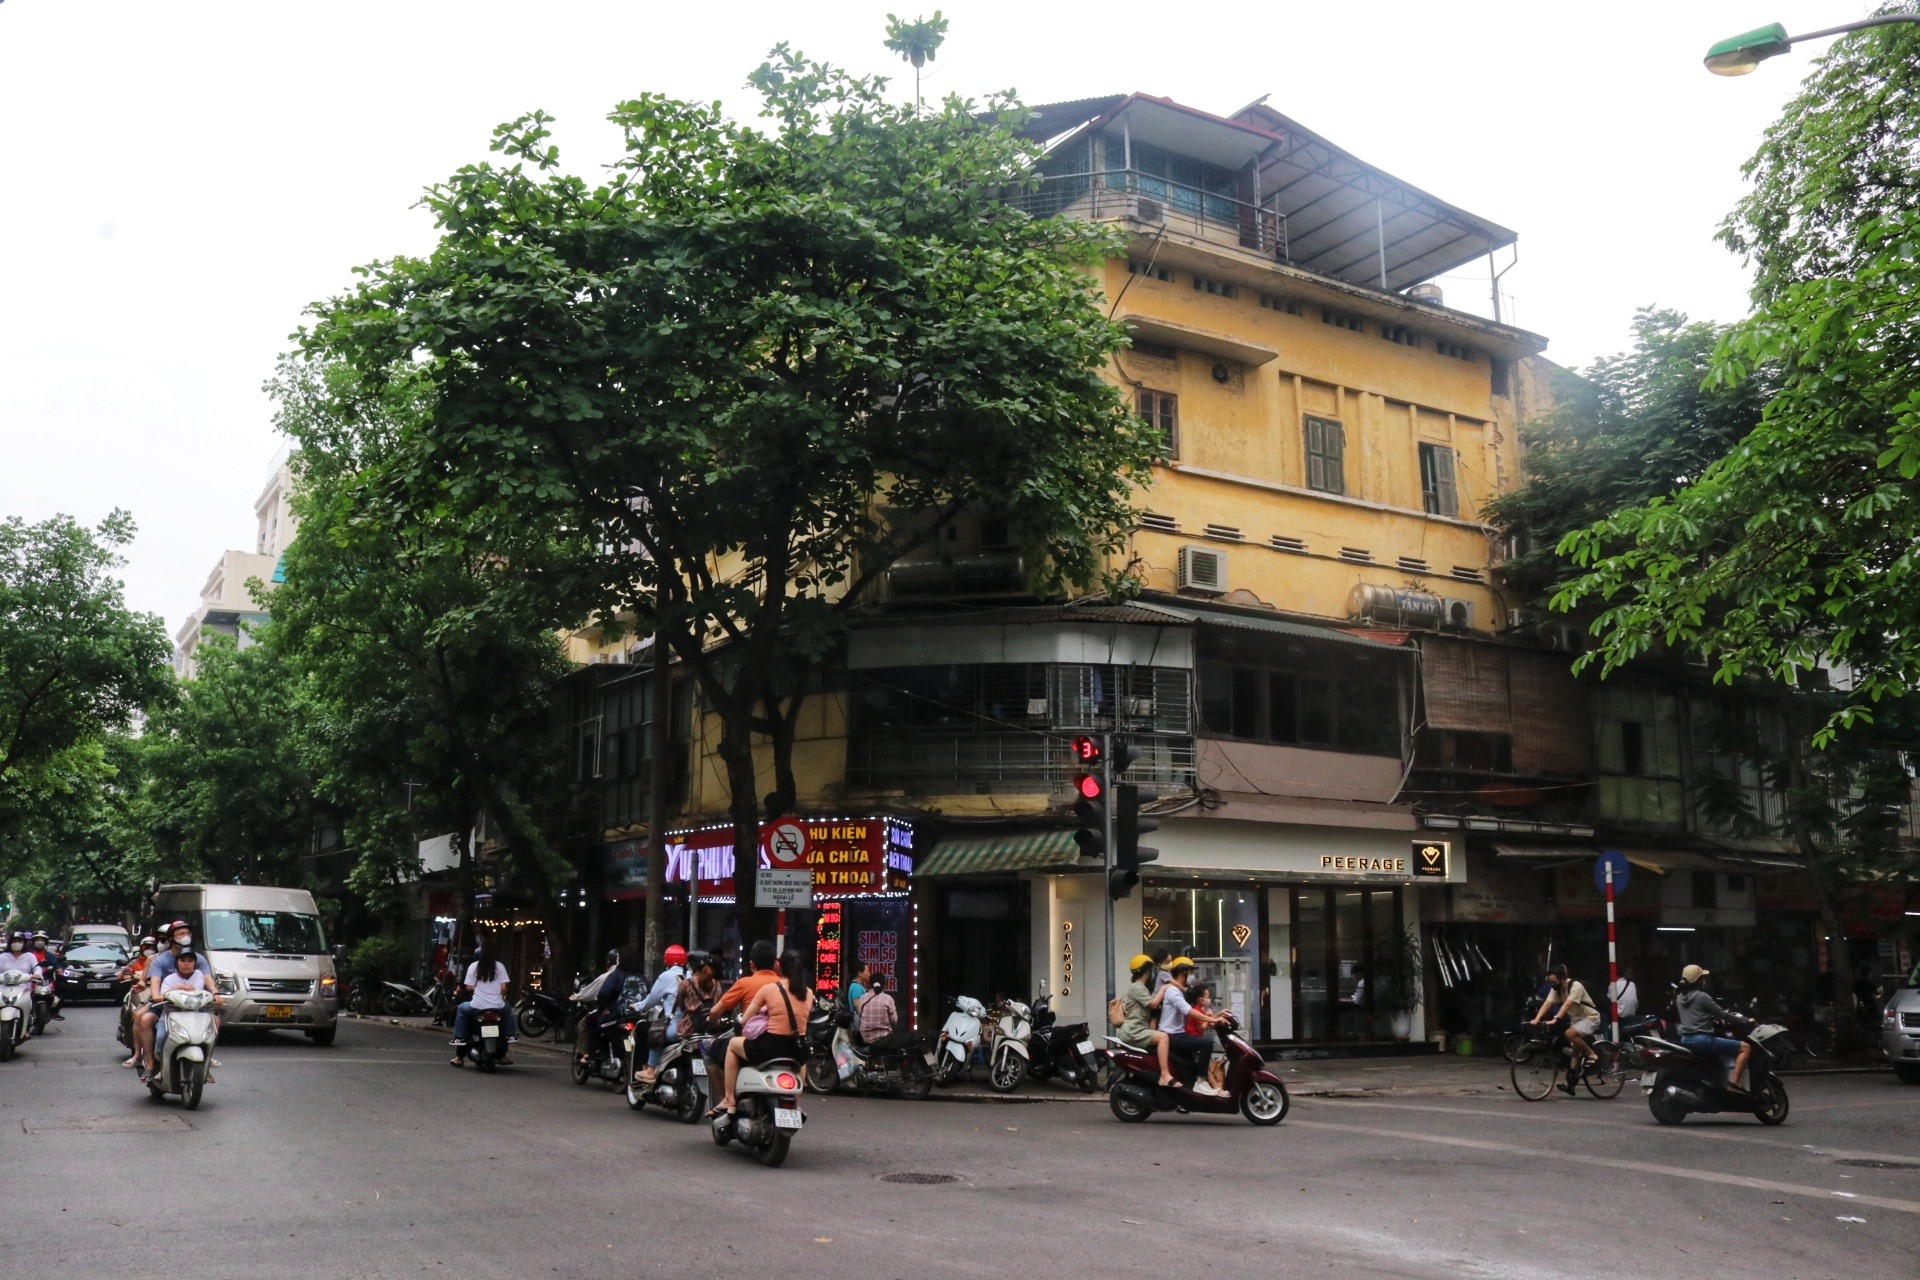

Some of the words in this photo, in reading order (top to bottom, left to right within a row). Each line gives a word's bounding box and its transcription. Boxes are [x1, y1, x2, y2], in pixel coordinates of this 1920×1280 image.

[1401, 598, 1420, 611] TÂN
[1421, 601, 1436, 613] MỸ
[809, 827, 828, 844] HỤ
[832, 823, 866, 844] KIỆN
[806, 846, 825, 864] ỬA
[829, 846, 869, 863] CHỮA
[1321, 856, 1406, 871] PEERAGE
[831, 871, 875, 888] THOẠI
[858, 931, 881, 946] SIM
[881, 931, 897, 946] 4G
[820, 953, 837, 963] CASE
[858, 946, 881, 962] SIM
[881, 946, 897, 962] 5G
[1062, 921, 1073, 997] DIAMOND
[867, 961, 894, 977] HONE
